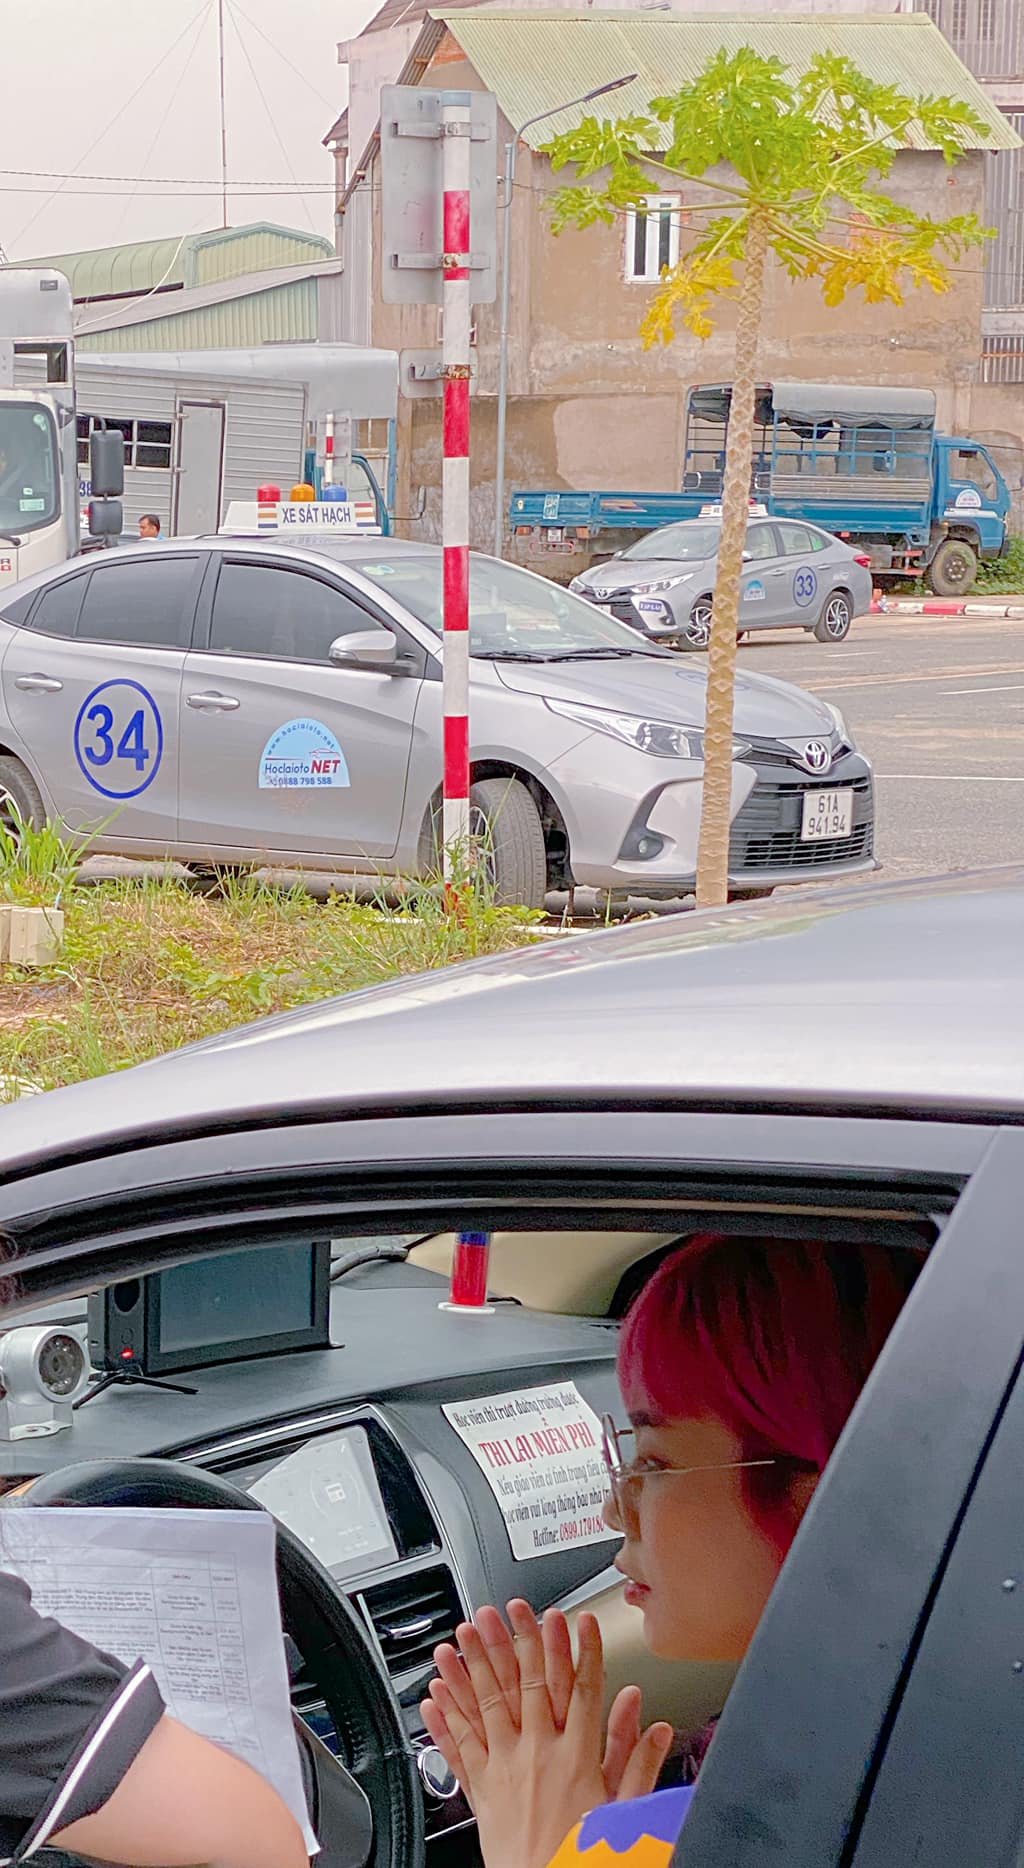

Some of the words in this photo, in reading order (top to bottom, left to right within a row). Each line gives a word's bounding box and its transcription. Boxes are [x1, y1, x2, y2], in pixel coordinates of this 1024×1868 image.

[282, 507, 297, 524] XE
[298, 503, 319, 524] SÁT
[321, 506, 352, 526] HẠCH
[796, 574, 815, 598] 33
[84, 704, 150, 771] 34
[265, 763, 309, 774] Hoclaioto
[310, 759, 341, 773] NET
[818, 794, 839, 813] 61A
[807, 814, 846, 836] 941.94
[479, 1438, 512, 1468] THI
[503, 1433, 537, 1468] LẠI
[532, 1526, 559, 1548] Hotline:
